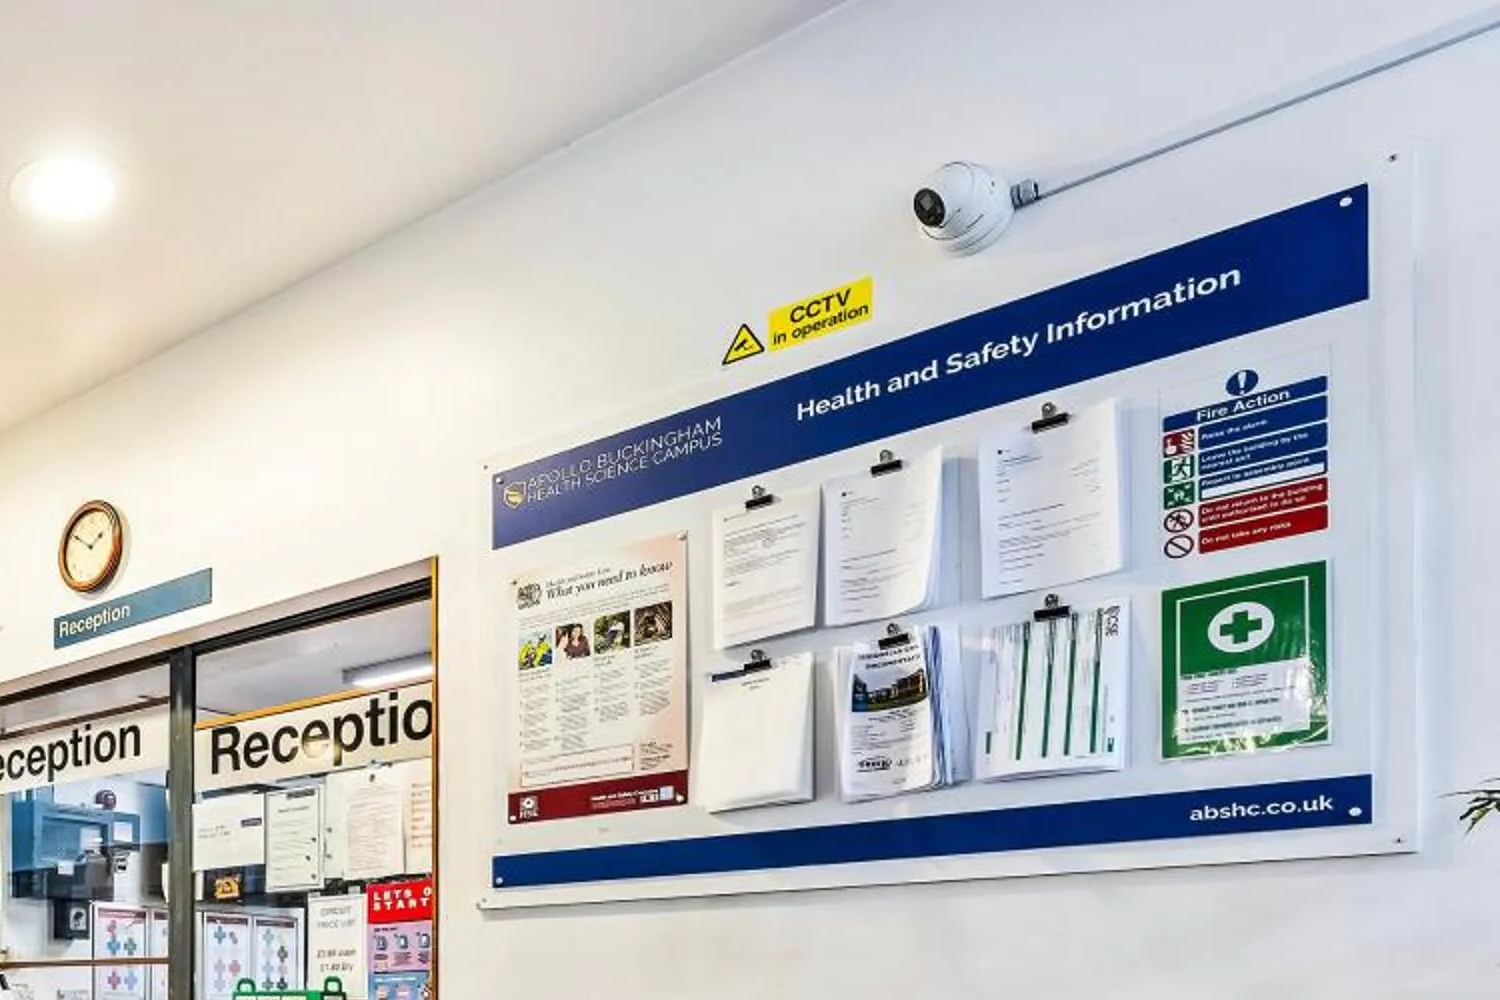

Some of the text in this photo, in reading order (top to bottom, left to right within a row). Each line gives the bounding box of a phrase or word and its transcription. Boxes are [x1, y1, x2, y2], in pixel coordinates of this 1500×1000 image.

[774, 305, 869, 345] in operation
[790, 288, 851, 323] CCTV
[797, 268, 1241, 421] Health and Safety Information
[1196, 390, 1291, 422] Fire Action
[527, 432, 723, 503] HEALTH SCIENCE CAMPUS
[528, 416, 722, 489] APOLLO BUCKINGHAM
[546, 585, 574, 601] What
[576, 580, 596, 597] you
[598, 569, 624, 589] need
[625, 566, 637, 581] to
[639, 560, 674, 578] know
[59, 605, 130, 638] Reception
[211, 692, 432, 775] Receptio
[1189, 795, 1333, 822] abshc.co.uk
